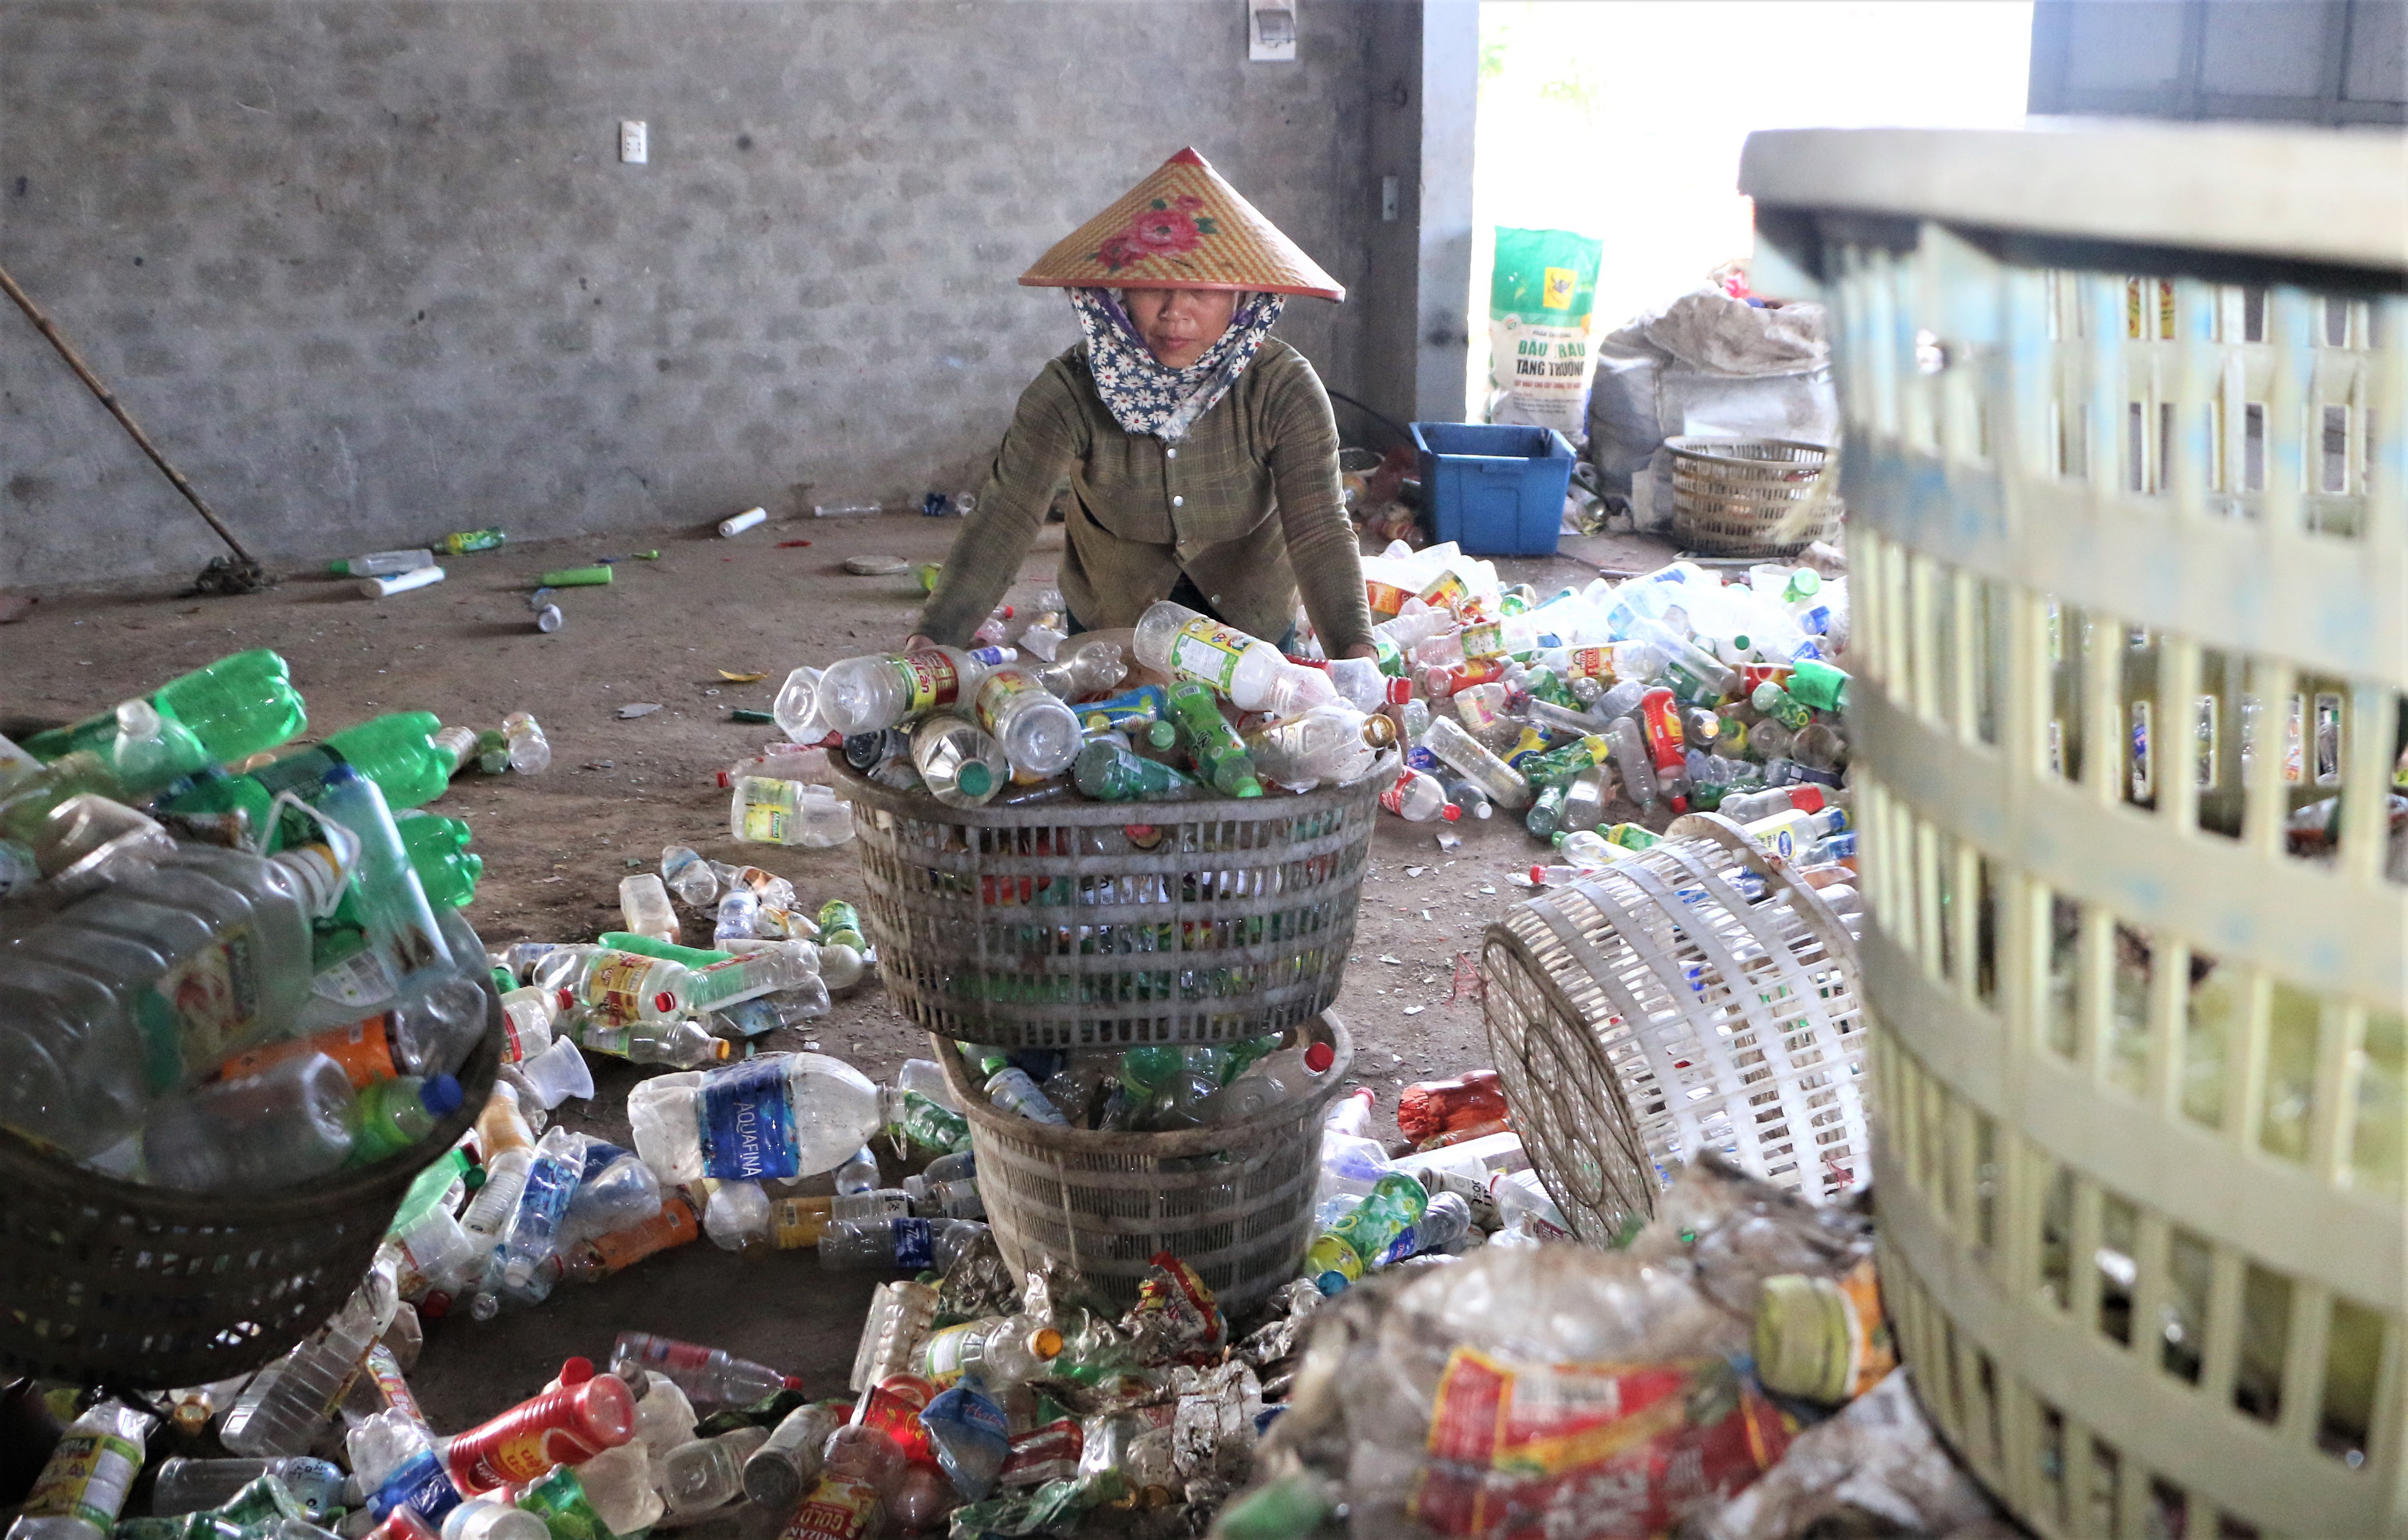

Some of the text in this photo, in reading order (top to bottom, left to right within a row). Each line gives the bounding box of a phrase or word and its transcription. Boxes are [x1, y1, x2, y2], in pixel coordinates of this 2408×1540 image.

[1781, 833, 1790, 856] Simply
[734, 1101, 763, 1177] AQUAFINA
[799, 1508, 844, 1531] GOLD
